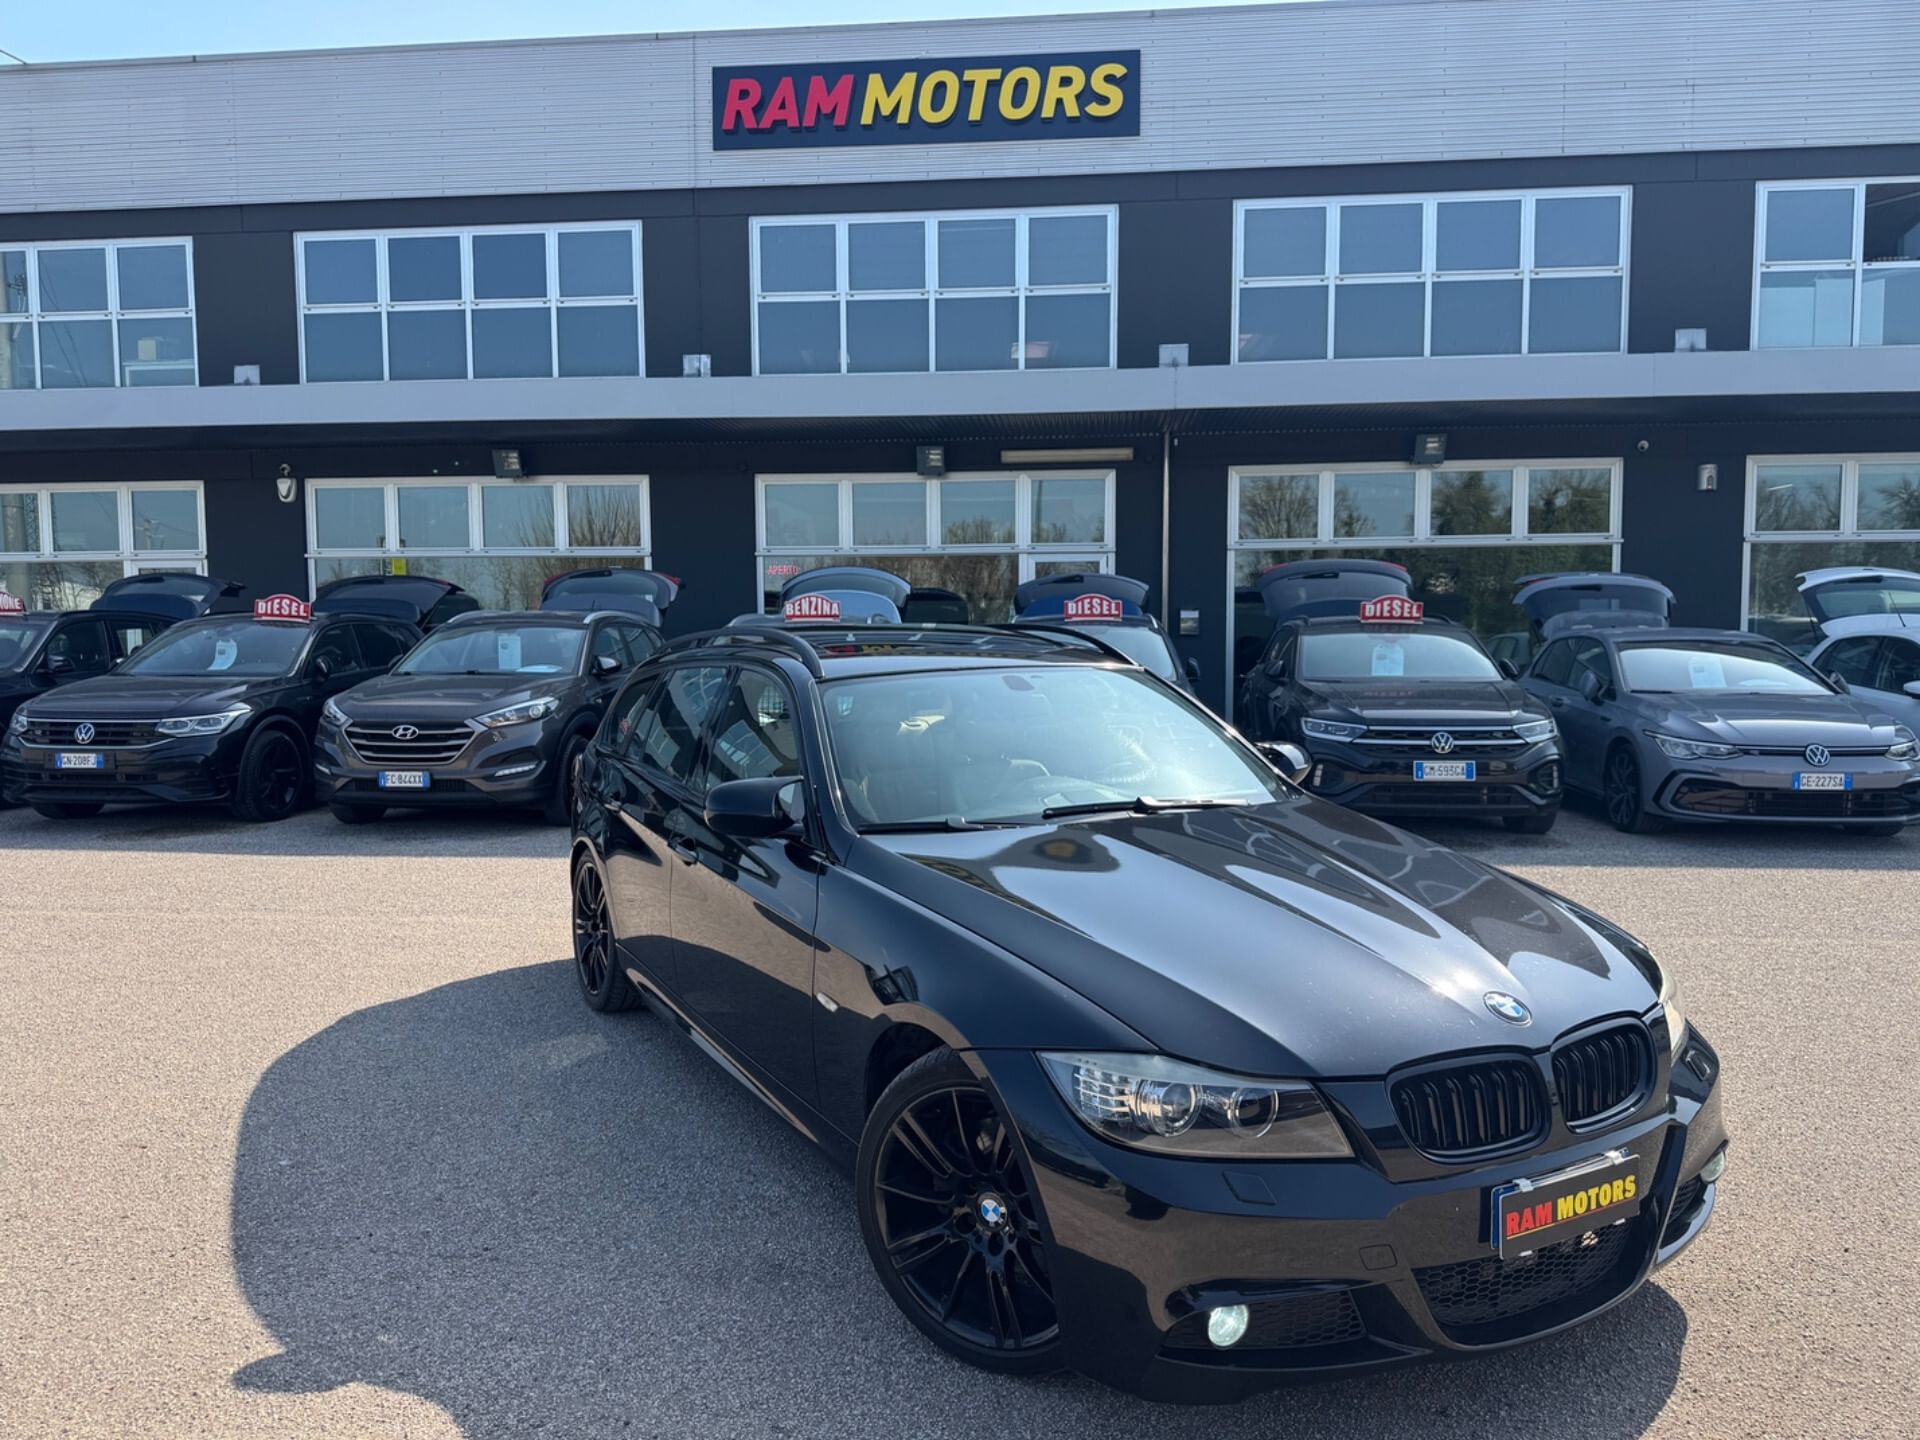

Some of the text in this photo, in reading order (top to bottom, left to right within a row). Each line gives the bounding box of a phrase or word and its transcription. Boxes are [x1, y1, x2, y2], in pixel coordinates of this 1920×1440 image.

[722, 63, 1128, 131] RAM MOTORS
[257, 598, 307, 617] DIESEL
[785, 595, 840, 616] BENZINA
[1067, 598, 1119, 615] DIESEL
[1364, 600, 1421, 618] DIESEL
[1506, 1175, 1637, 1237] RAM MOTORS
